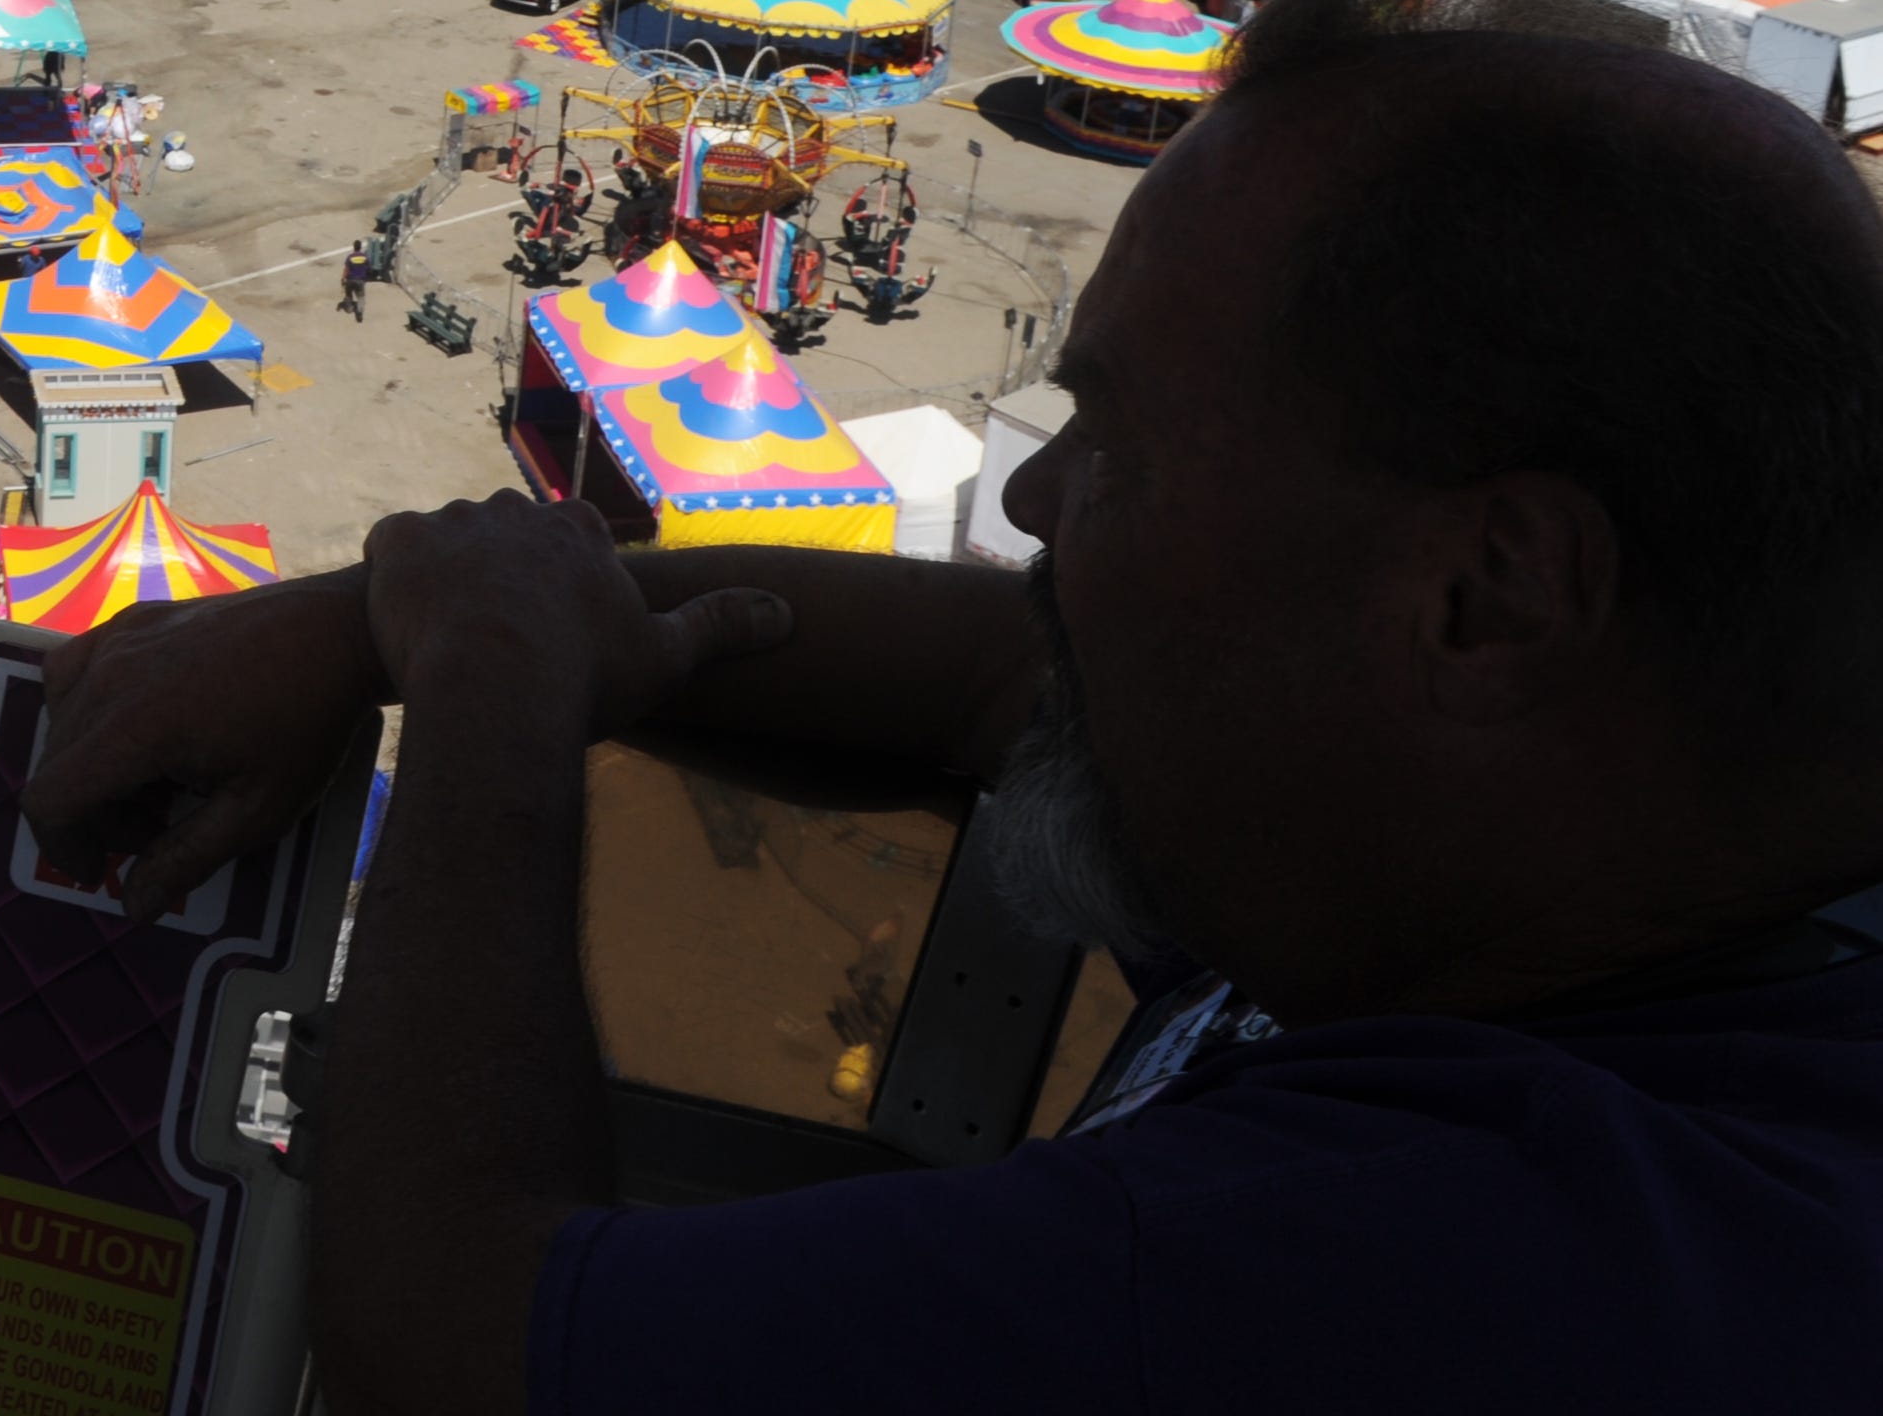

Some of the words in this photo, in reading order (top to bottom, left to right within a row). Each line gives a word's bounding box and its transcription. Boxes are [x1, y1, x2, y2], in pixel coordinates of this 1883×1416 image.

[29, 1287, 79, 1320] OWN
[84, 1302, 166, 1342] SAFETY
[48, 1329, 93, 1359] AND
[97, 1342, 158, 1377] ARMS
[13, 1353, 114, 1402] GONDOLA
[119, 1381, 165, 1414] AND
